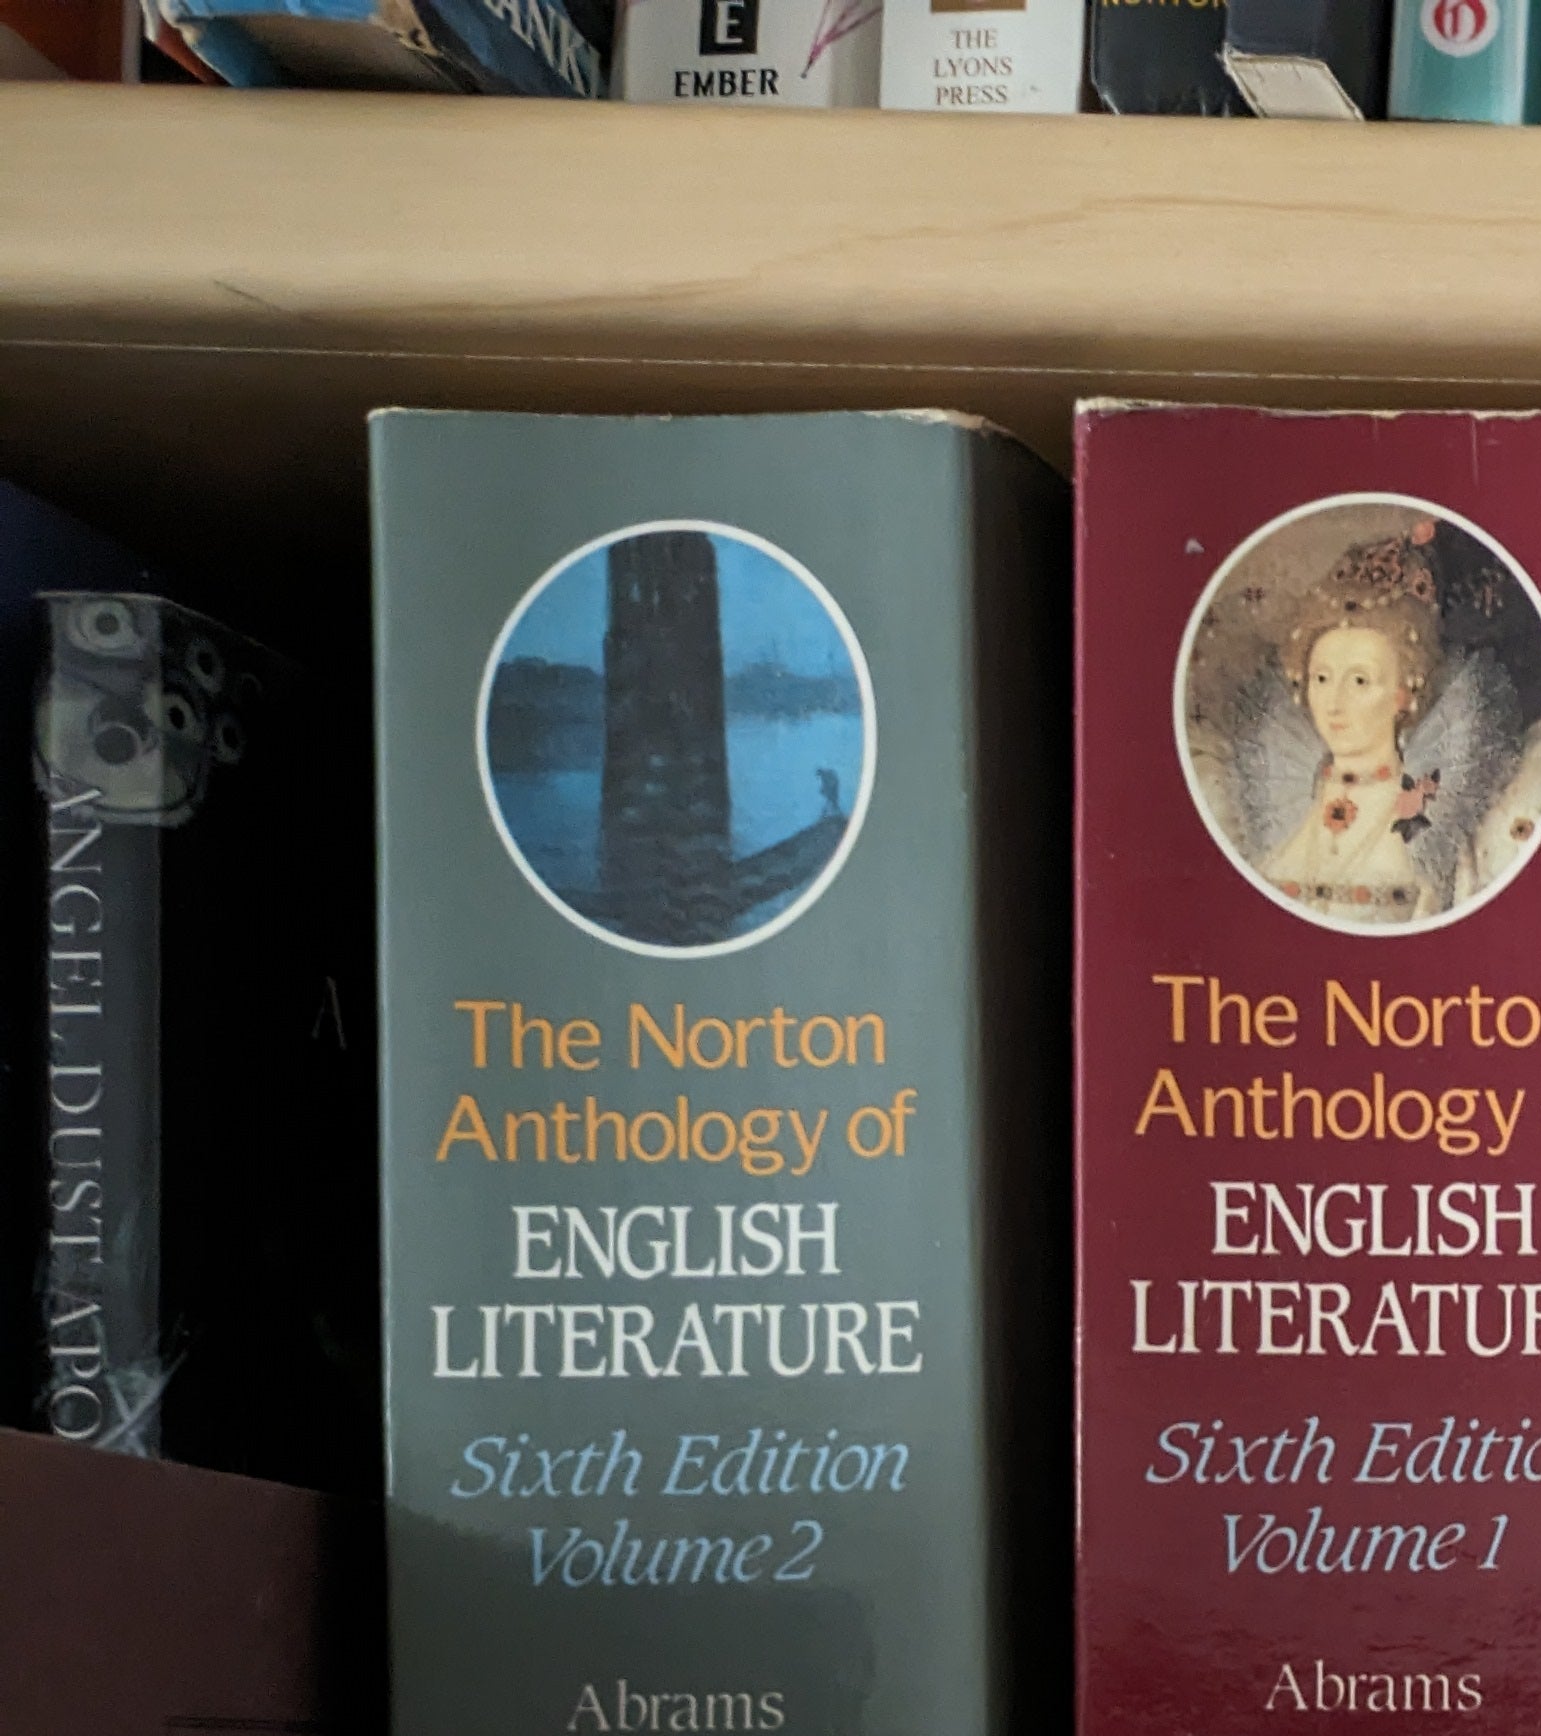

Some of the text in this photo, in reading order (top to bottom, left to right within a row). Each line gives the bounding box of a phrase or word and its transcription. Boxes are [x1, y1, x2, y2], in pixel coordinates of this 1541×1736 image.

[933, 56, 1014, 79] LYONS
[952, 28, 998, 50] THE
[674, 68, 781, 98] EMBER
[935, 85, 1009, 106] PRESS
[48, 773, 104, 1046] ANGEL
[454, 1000, 887, 1069] The Norton
[1153, 975, 1298, 1047] The
[435, 1089, 918, 1176] Anthology of
[1135, 1068, 1526, 1156] Anthology
[48, 1070, 104, 1266] DUST
[513, 1202, 841, 1280] ENGLISH
[1210, 1181, 1538, 1257] ENGLISH
[431, 1300, 923, 1378] LITERATURE
[450, 1429, 909, 1498] Sixth Edition
[1146, 1416, 1335, 1485] Sixth
[528, 1517, 824, 1588] Volume 2
[1224, 1506, 1510, 1574] Volume 1
[567, 1679, 786, 1732] Abrams
[1266, 1660, 1483, 1712] Abrams
